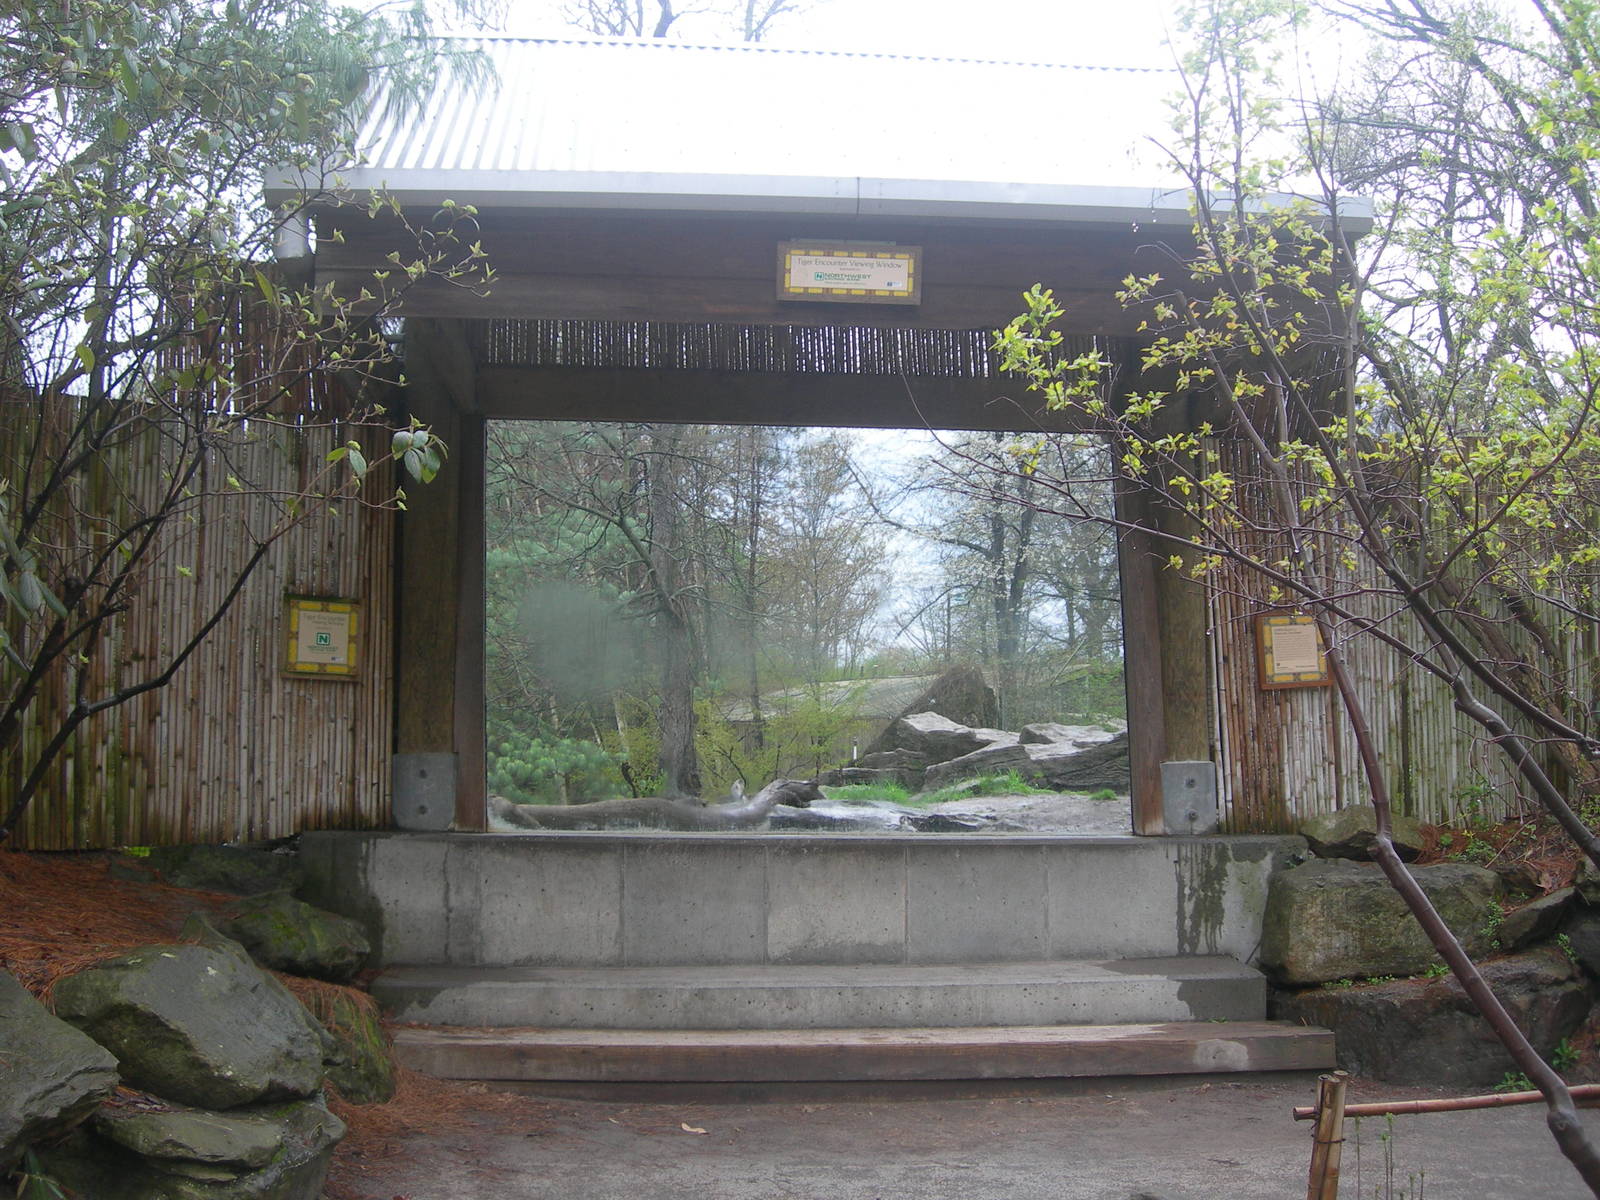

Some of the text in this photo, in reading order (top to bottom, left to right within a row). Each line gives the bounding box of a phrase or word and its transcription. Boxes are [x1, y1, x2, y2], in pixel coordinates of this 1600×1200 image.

[815, 258, 848, 267] Encounter
[849, 259, 874, 269] Viewing
[875, 260, 902, 269] Window
